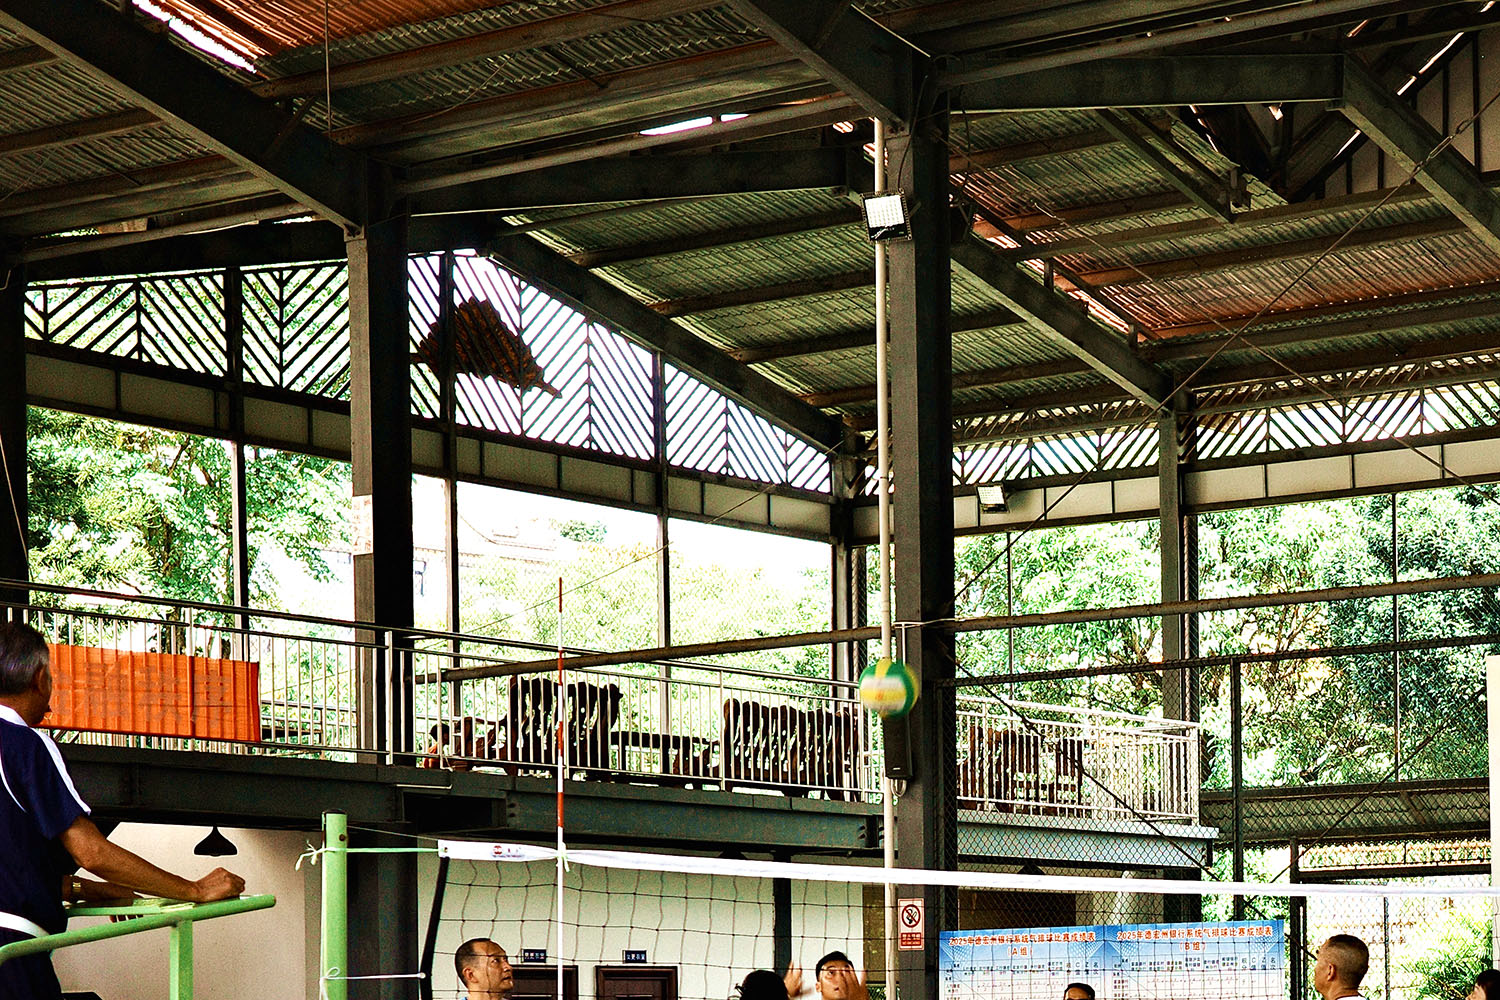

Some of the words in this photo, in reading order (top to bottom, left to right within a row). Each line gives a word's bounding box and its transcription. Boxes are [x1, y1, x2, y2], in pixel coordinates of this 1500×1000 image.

[1117, 926, 1273, 940] 2025年德宏州银行系统气排球比赛成绩表
